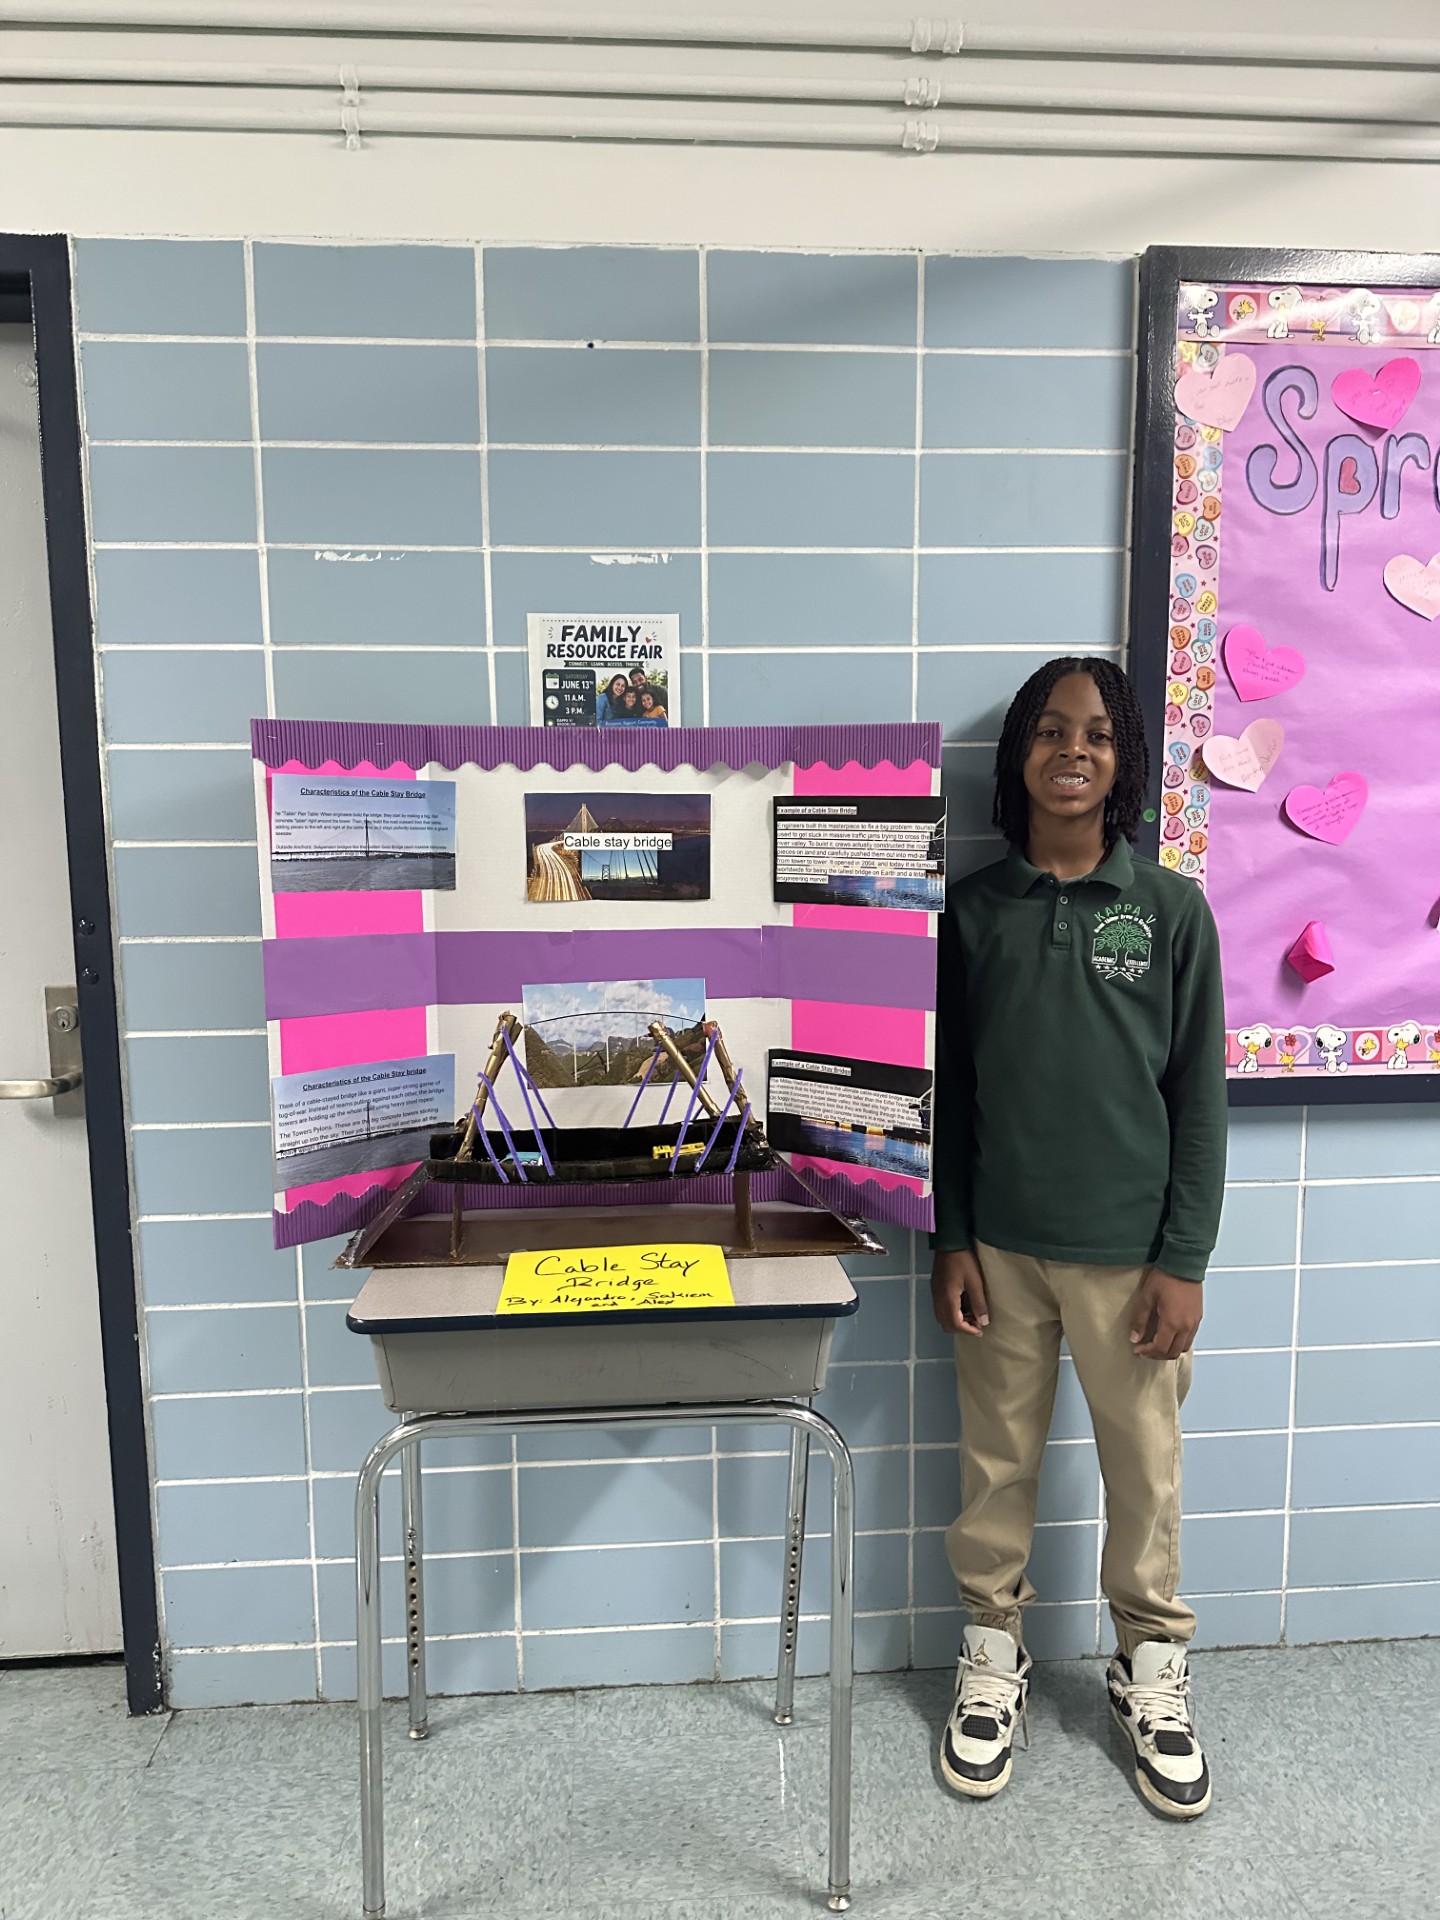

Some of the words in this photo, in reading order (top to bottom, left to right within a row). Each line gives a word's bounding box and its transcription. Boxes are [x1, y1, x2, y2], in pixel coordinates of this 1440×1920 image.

[1246, 365, 1440, 591] Spr
[1200, 596, 1211, 610] SWEET
[561, 625, 641, 643] FAMILY
[547, 643, 626, 659] RESOURCE
[630, 644, 663, 659] FAIR
[561, 680, 580, 689] JUNE
[571, 694, 586, 702] A.M.
[300, 788, 350, 796] Characteristics
[406, 791, 426, 799] Bridge
[564, 835, 600, 848] Cable
[604, 837, 630, 850] stay
[633, 836, 672, 850] bridge
[1094, 903, 1141, 922] KAPPA
[834, 1067, 851, 1075] Bridge
[303, 1078, 351, 1091] Characteristics
[372, 1072, 390, 1080] Cable
[391, 1070, 405, 1078] Stay
[407, 1068, 426, 1076] bridge
[307, 1095, 340, 1105] cable-stayed
[340, 1091, 357, 1100] bridge
[372, 1095, 391, 1103] against
[308, 1113, 328, 1122] holding
[292, 1128, 312, 1136] Towers
[535, 1256, 626, 1276] Cable
[640, 1252, 700, 1277] Stay
[557, 1276, 659, 1291] Bridge
[505, 1296, 544, 1307] By:
[636, 1298, 675, 1306] Alex
